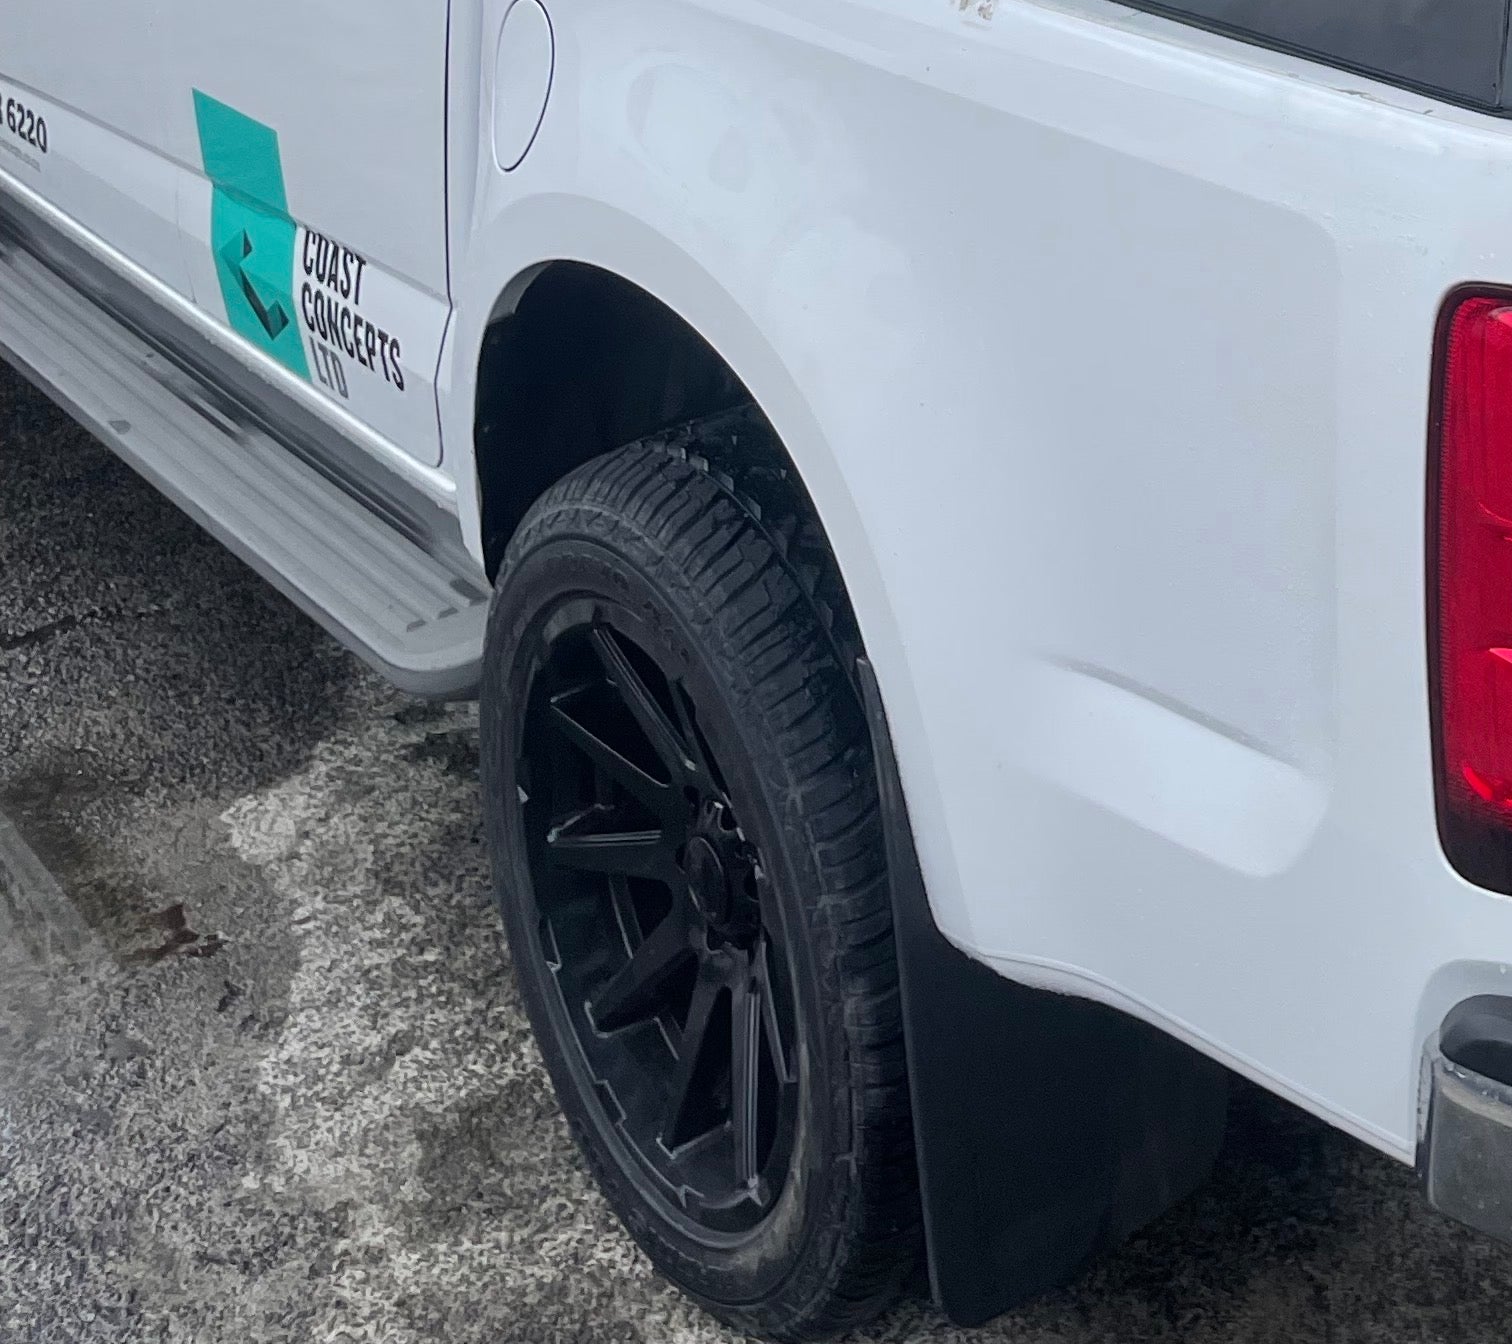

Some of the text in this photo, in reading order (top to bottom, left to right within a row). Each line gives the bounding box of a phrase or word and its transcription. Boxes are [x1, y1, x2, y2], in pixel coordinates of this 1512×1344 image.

[7, 98, 47, 153] 6220
[303, 230, 366, 305] COAST
[302, 282, 405, 391] CONCEPTS
[309, 335, 349, 400] LTD
